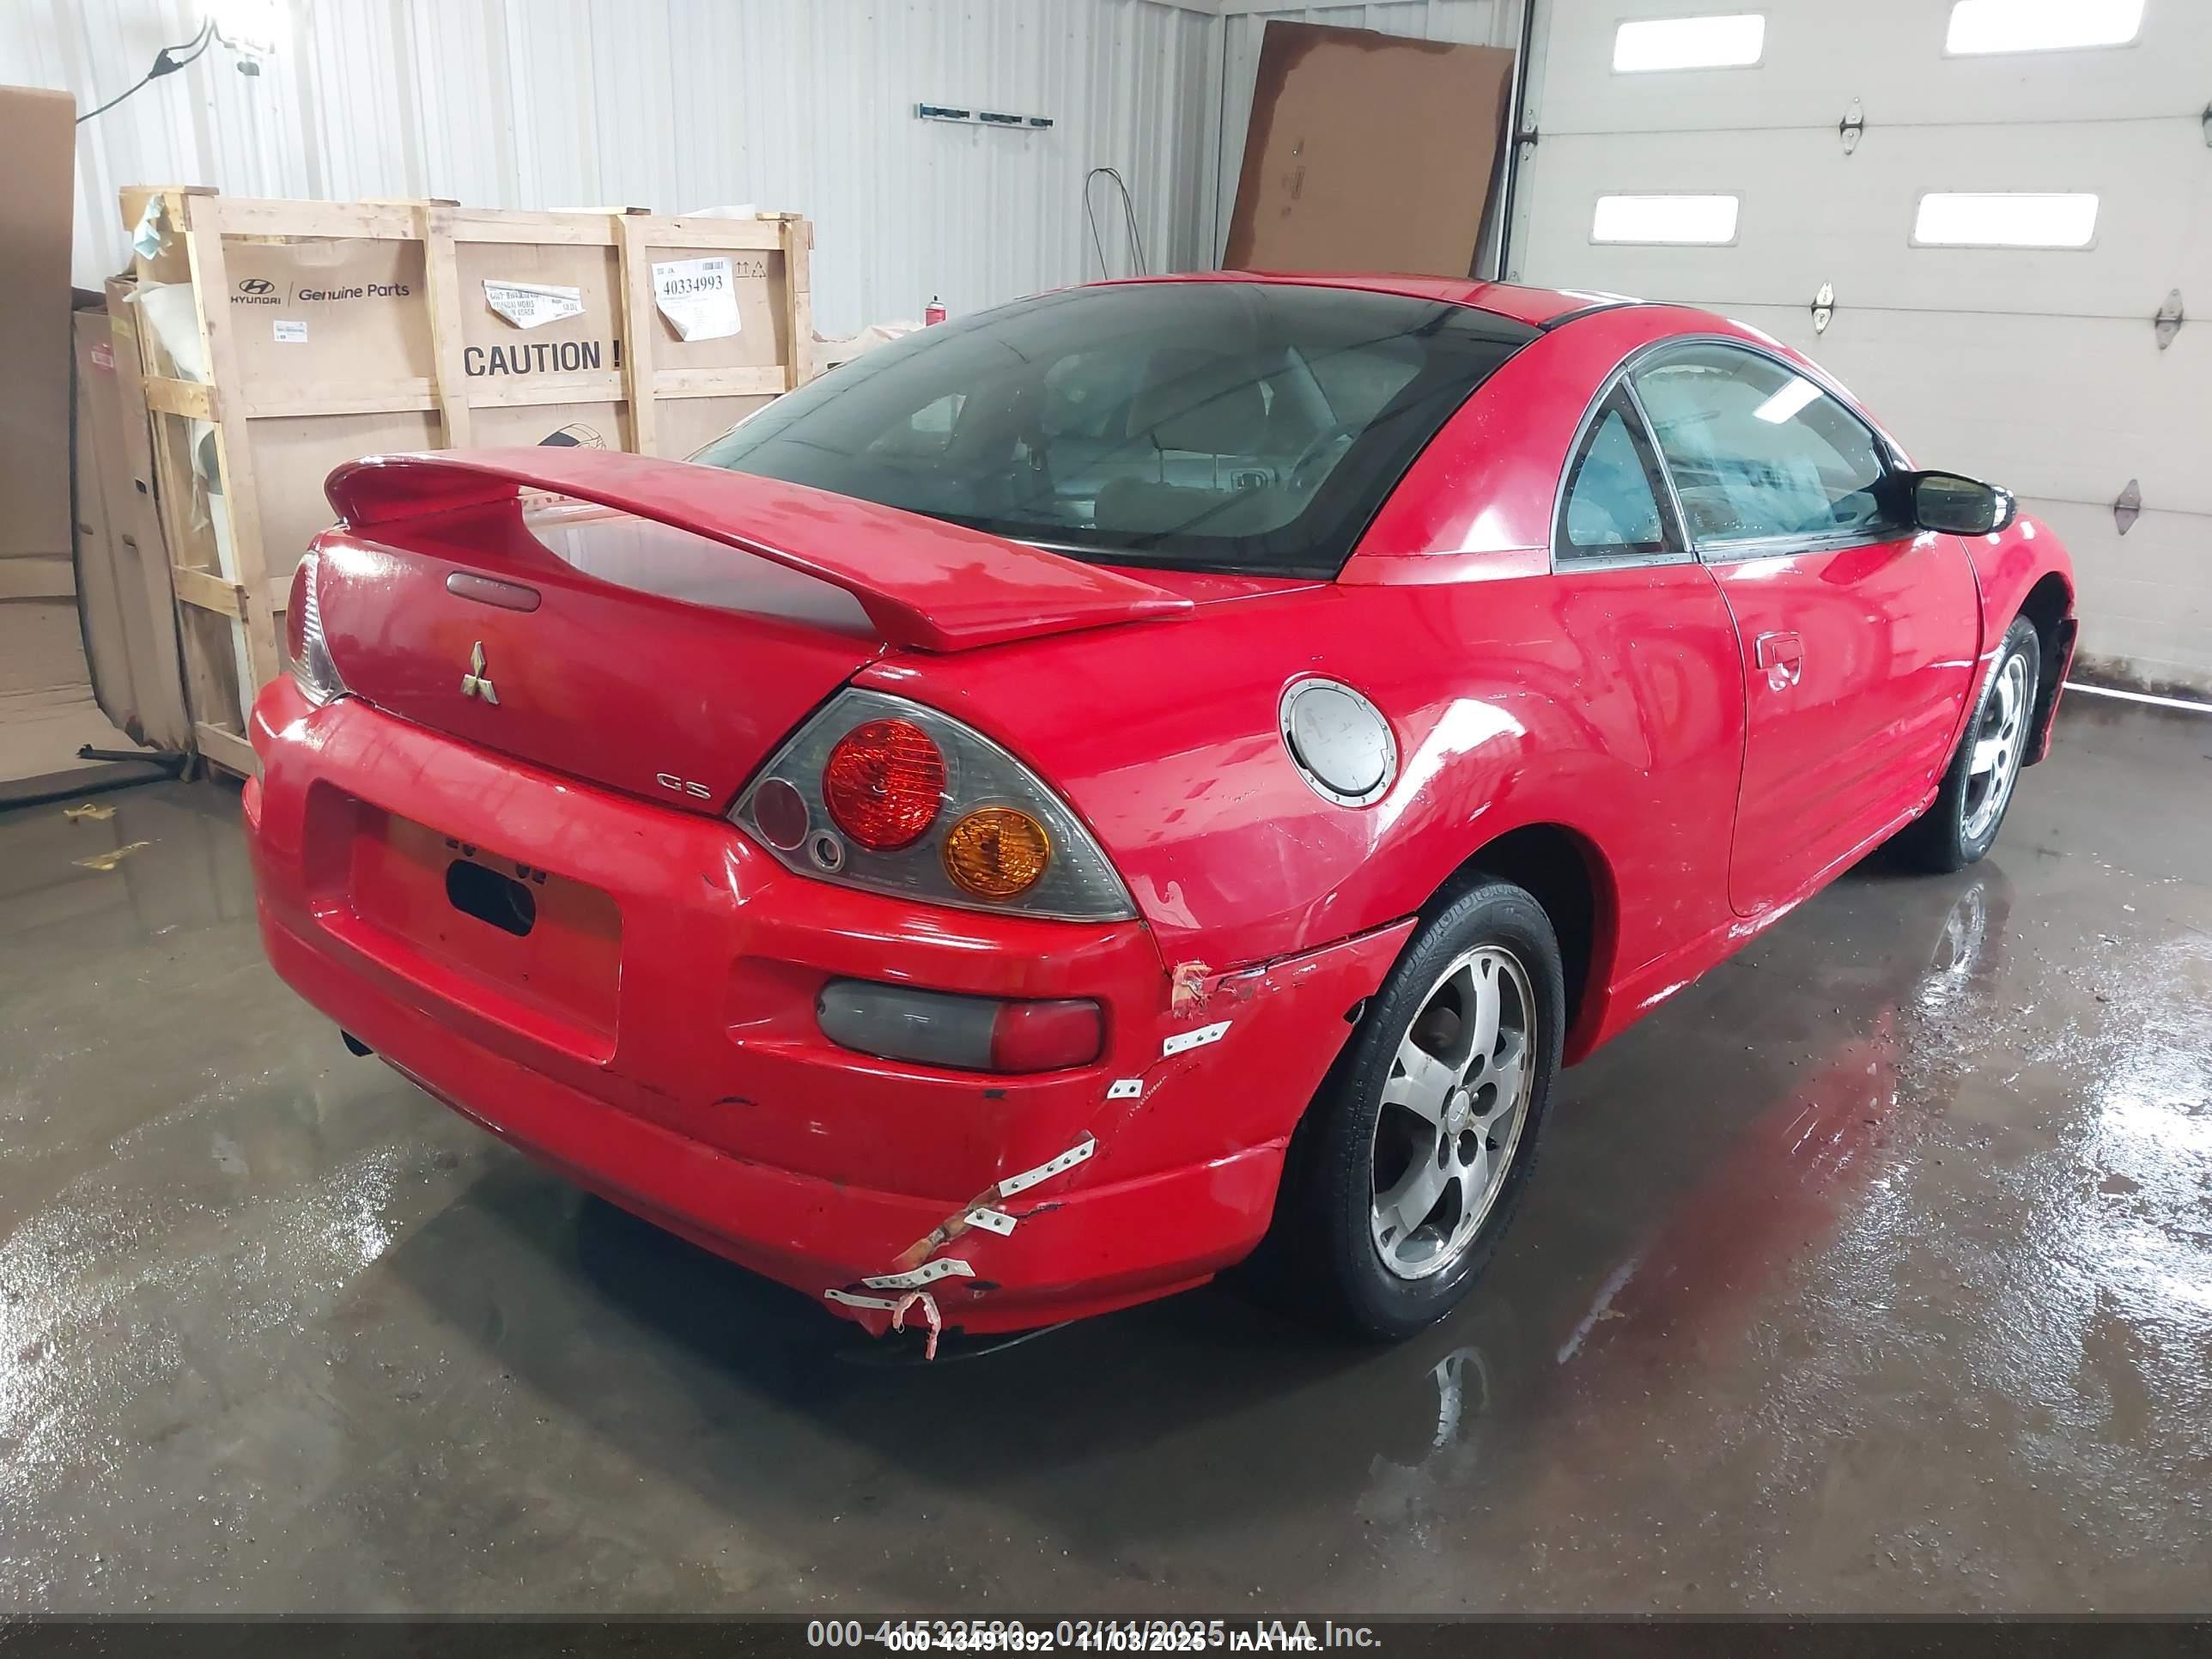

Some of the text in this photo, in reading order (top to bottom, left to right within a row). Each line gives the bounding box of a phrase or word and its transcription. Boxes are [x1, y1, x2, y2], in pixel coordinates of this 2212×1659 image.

[298, 283, 410, 301] Genuine Parts
[663, 275, 723, 295] 40334993
[230, 296, 281, 305] HYUNDAI
[464, 341, 600, 376] CAUTION
[656, 773, 712, 799] GS
